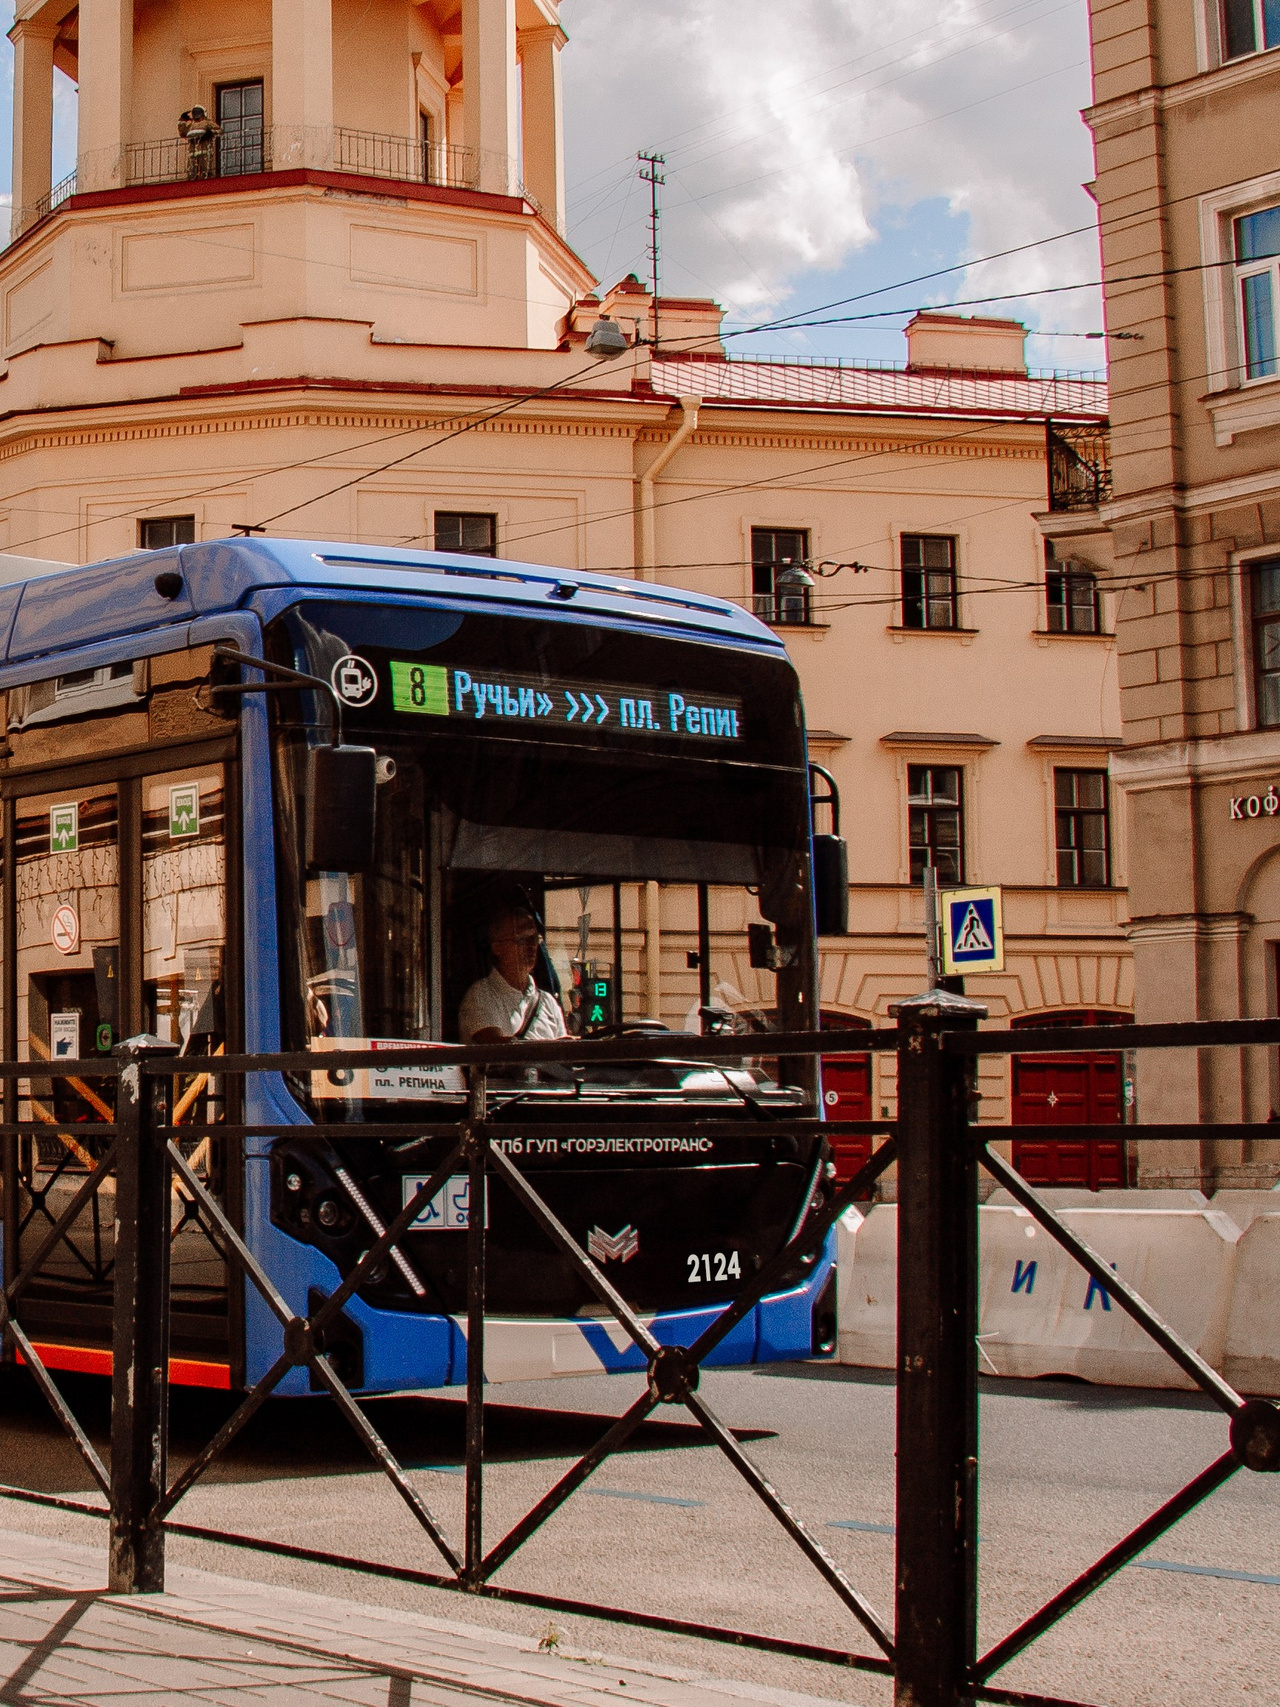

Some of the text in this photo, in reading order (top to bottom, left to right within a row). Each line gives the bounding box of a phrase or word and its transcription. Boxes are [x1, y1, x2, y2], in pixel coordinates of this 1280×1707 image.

[408, 666, 425, 707] 8
[454, 670, 554, 719] Ручьи»
[620, 698, 661, 730] пл.
[593, 982, 607, 997] 13
[375, 1076, 446, 1090] пл. РЕПИНА
[526, 1138, 558, 1153] ГУП
[561, 1138, 713, 1153] «ГОРЭЛЕКТРОТРАНС»
[687, 1251, 741, 1283] 2124
